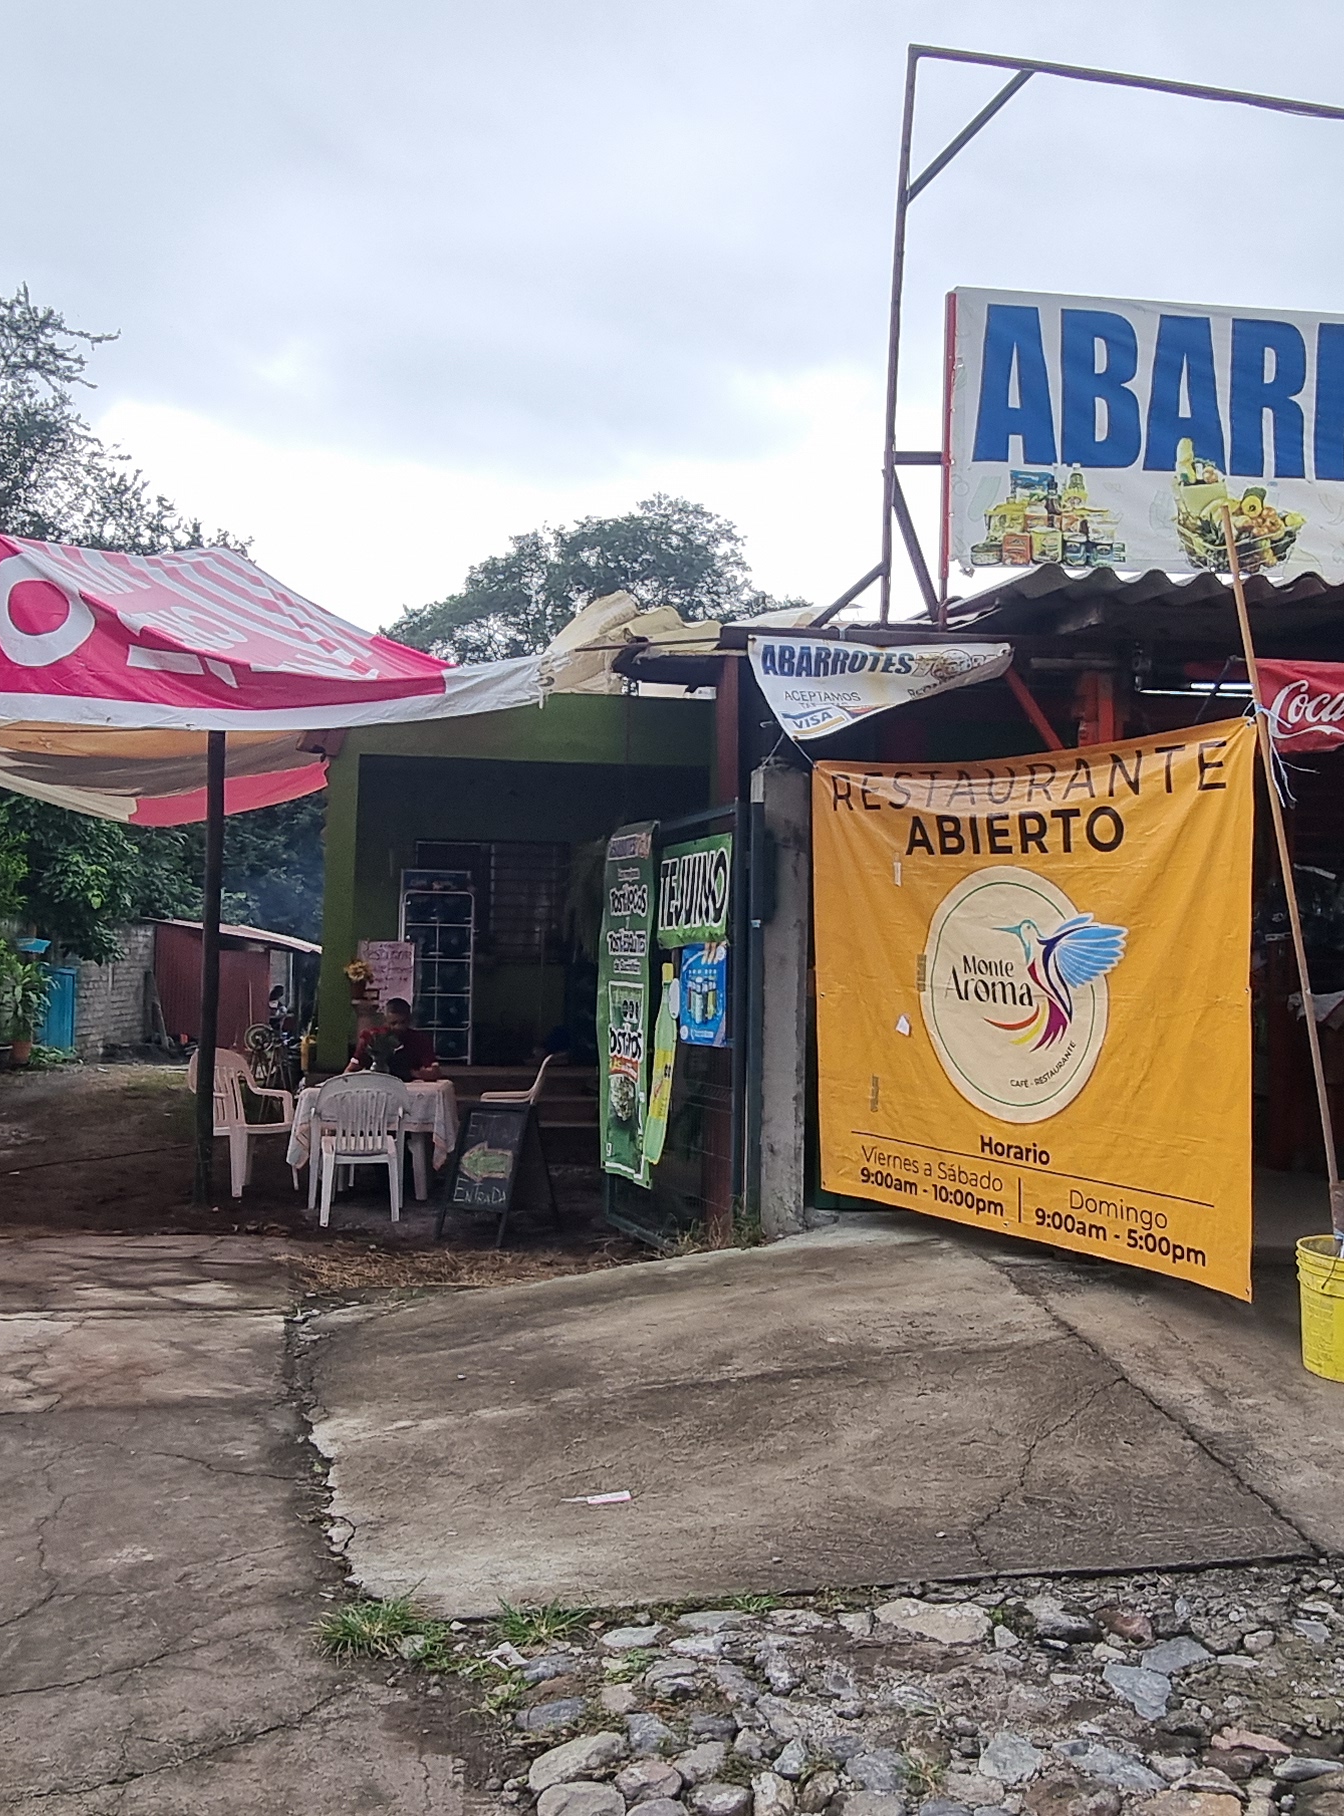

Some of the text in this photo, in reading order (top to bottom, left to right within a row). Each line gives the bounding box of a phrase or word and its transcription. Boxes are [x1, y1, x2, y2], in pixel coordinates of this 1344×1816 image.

[761, 644, 913, 679] ABARROTES
[784, 690, 861, 702] ACEPTAMOS
[793, 711, 833, 729] VISA
[832, 739, 1227, 812] RESTAURANTE
[905, 806, 1125, 857] ABIERTO
[659, 847, 729, 931] TEJUINO
[944, 964, 1034, 1008] Aroma
[962, 954, 1014, 978] Monte
[1034, 1040, 1077, 1087] RESTAURANTE
[861, 1145, 1003, 1192] Viernes a Sábado
[979, 1134, 1051, 1166] Horario
[860, 1167, 918, 1196] 9:00am
[932, 1183, 1005, 1217] 10:00pm
[1069, 1189, 1168, 1231] Domingo
[1035, 1207, 1107, 1241] 9:00am
[1126, 1228, 1206, 1267] 5:00pm
